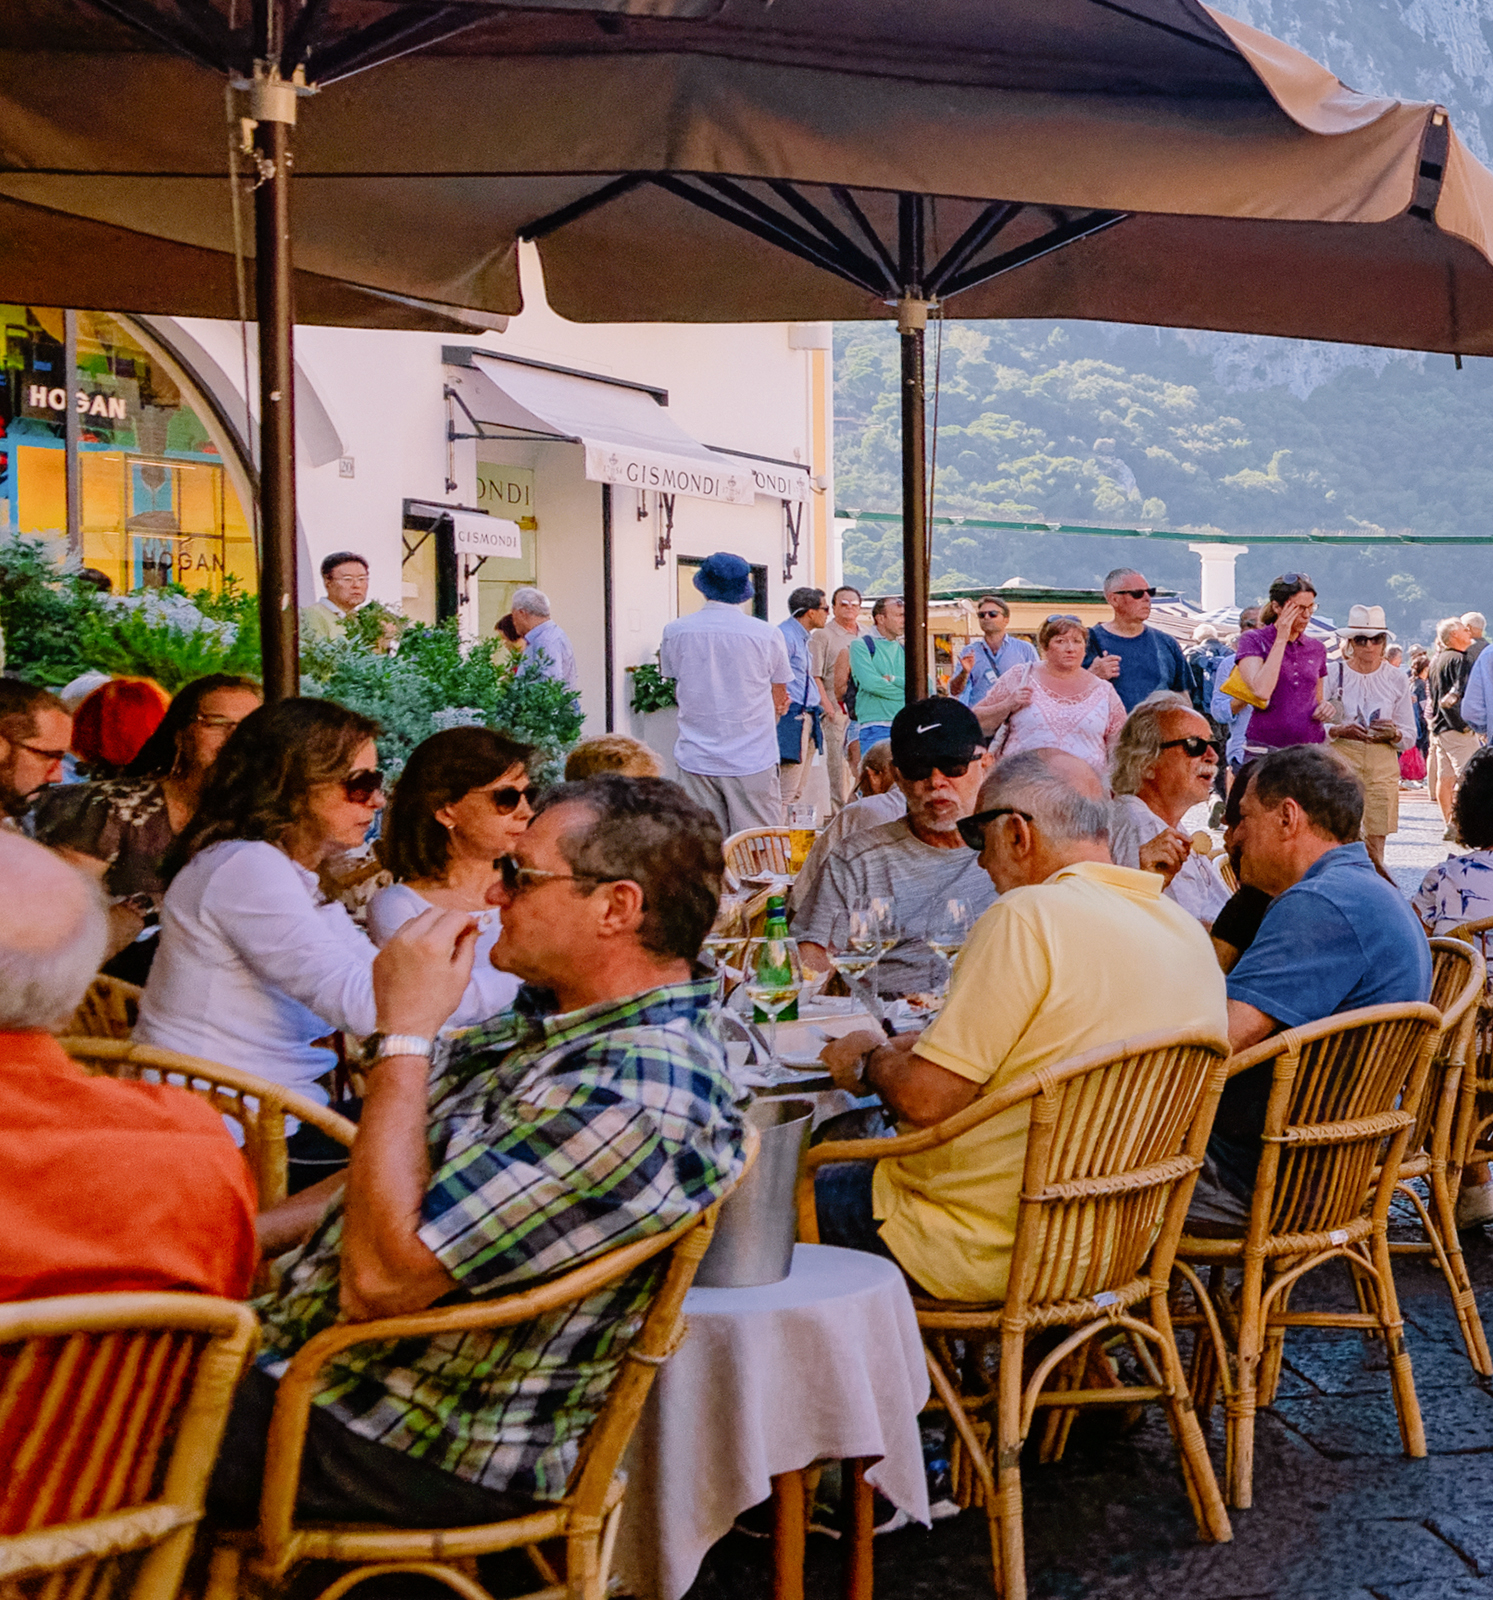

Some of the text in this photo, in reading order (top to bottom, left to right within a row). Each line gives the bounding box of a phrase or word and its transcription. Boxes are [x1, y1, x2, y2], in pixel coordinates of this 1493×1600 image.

[29, 384, 127, 420] HOGAN
[626, 462, 720, 496] GISMONDI
[458, 530, 517, 548] GISMONDI
[142, 550, 226, 573] HOGAN
